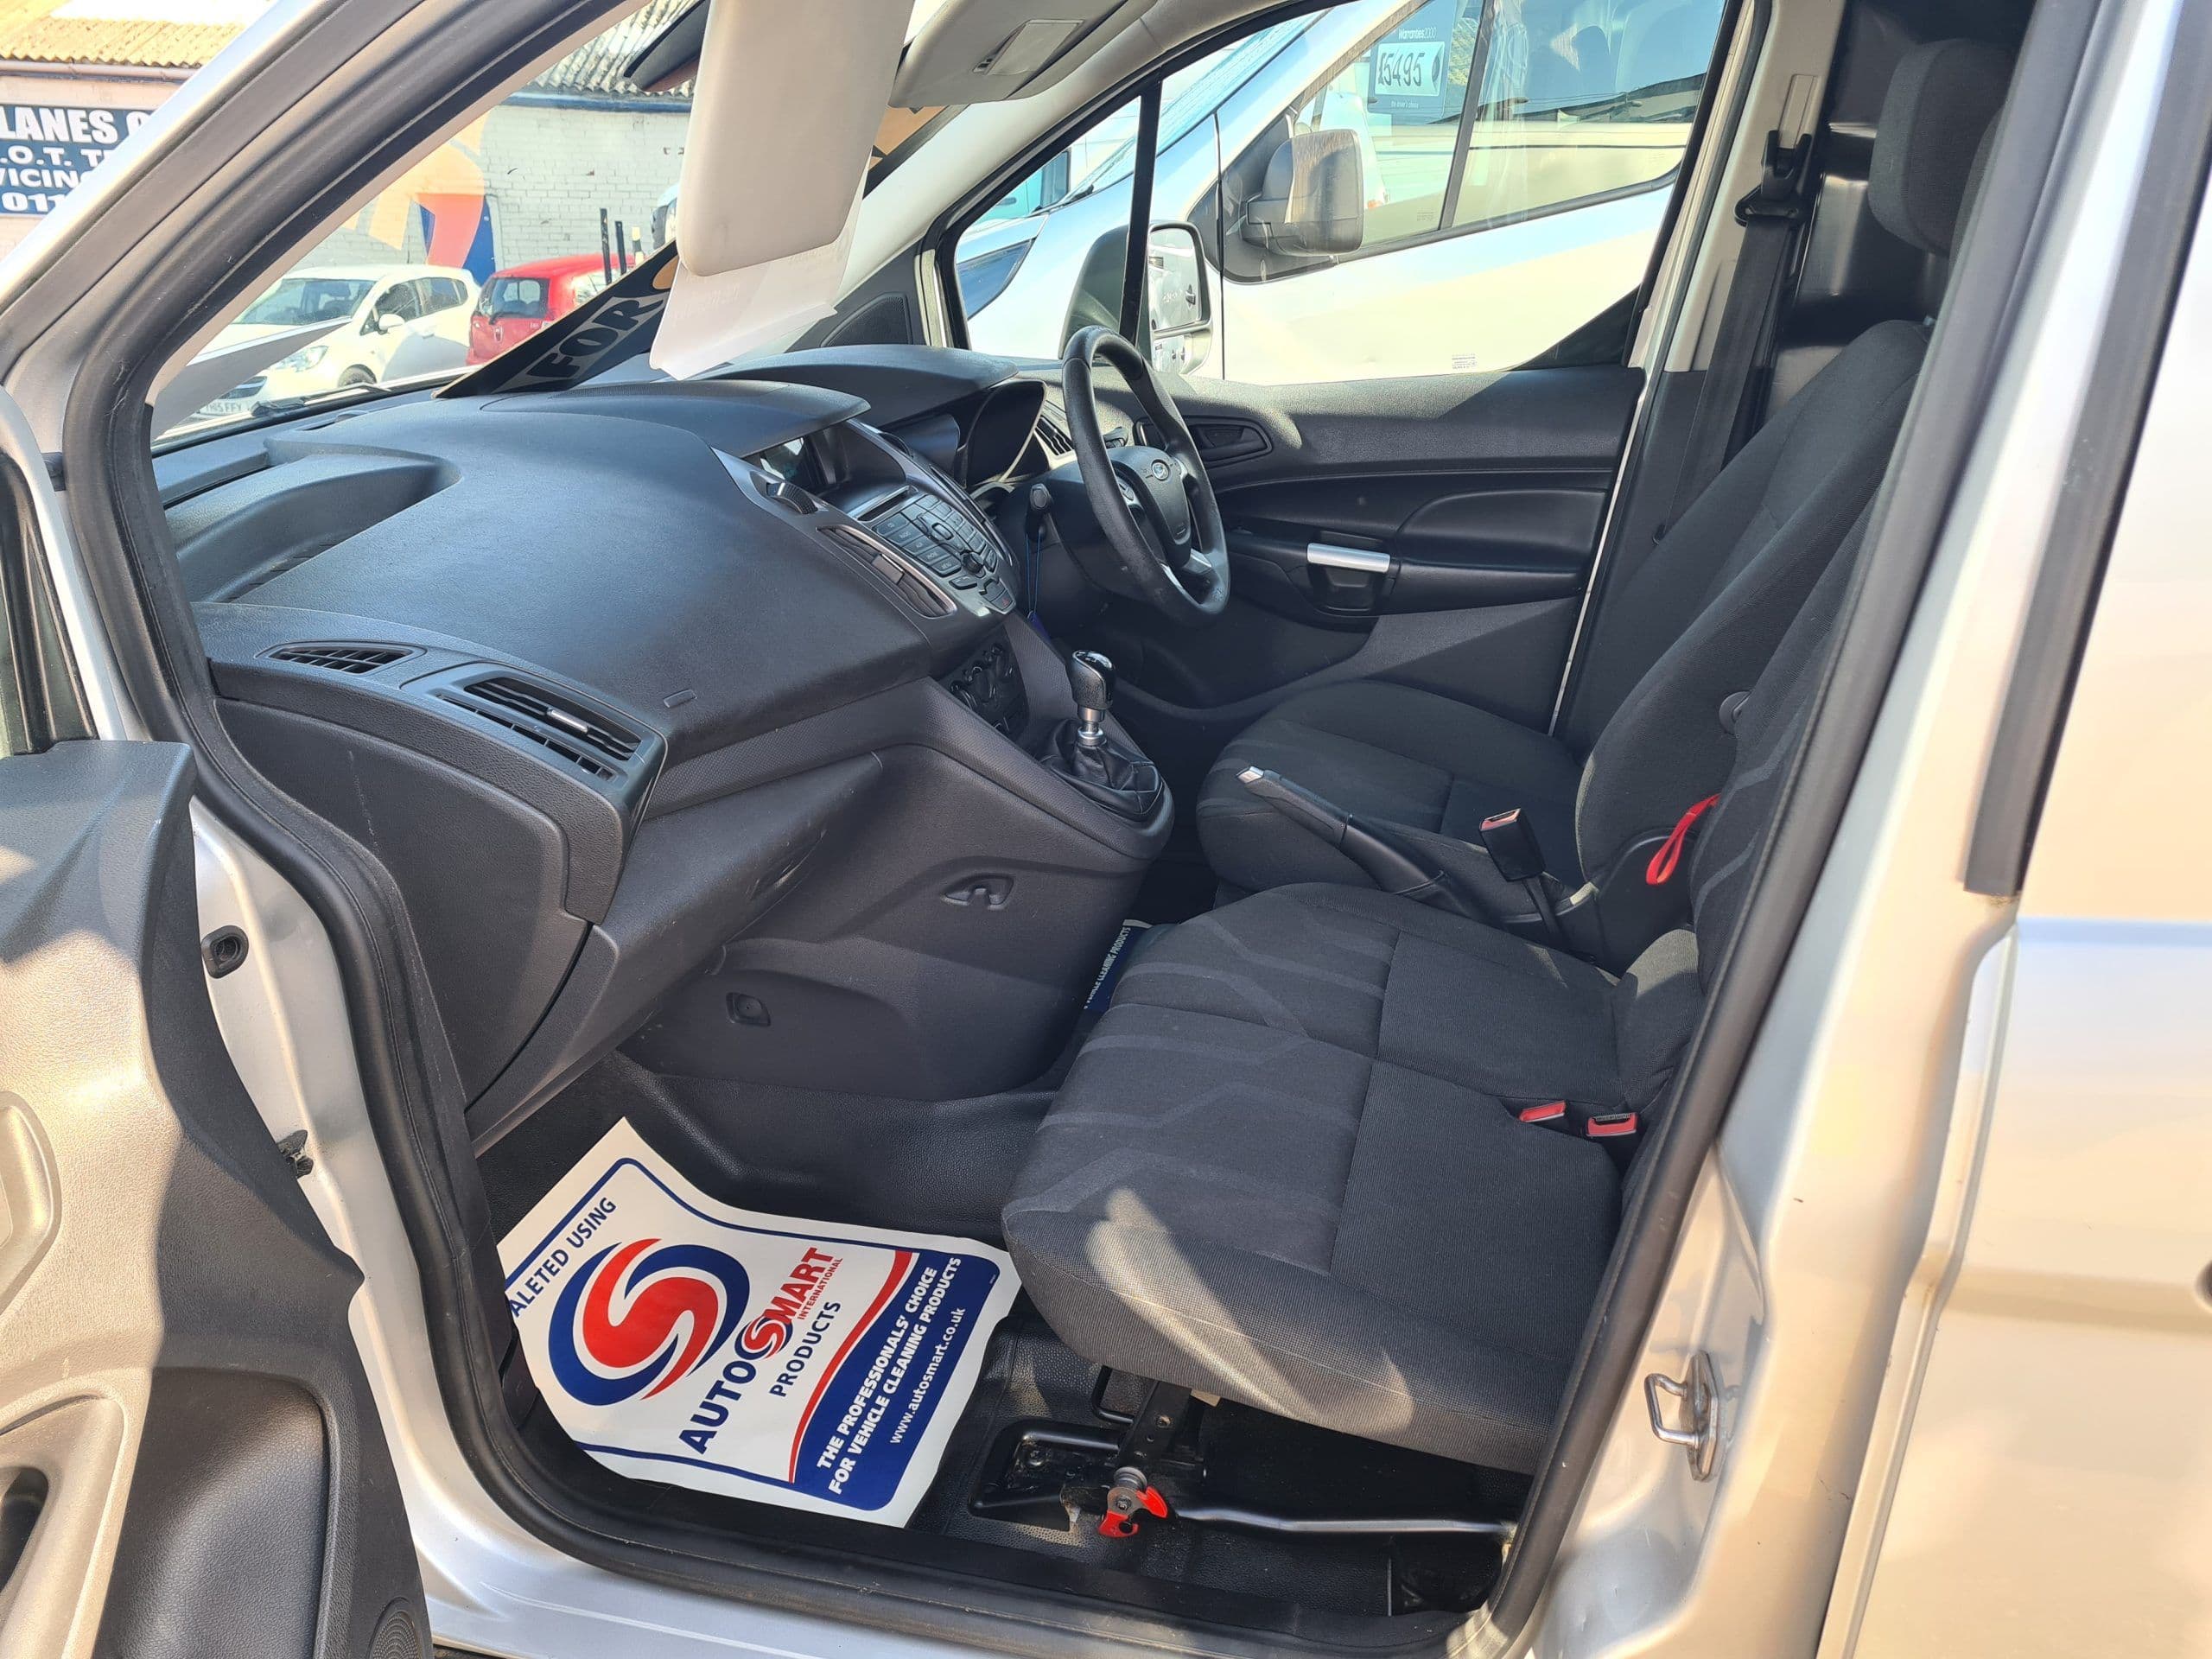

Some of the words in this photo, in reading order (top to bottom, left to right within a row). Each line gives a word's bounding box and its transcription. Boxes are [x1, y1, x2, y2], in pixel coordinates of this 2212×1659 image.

[1378, 52, 1425, 86] £5495
[509, 1249, 569, 1319] ALETED
[566, 1197, 617, 1249] USING
[797, 1257, 843, 1320] INTERNATIONAL
[769, 1301, 842, 1397] PRODUCTS
[817, 1436, 844, 1469] THE
[836, 1315, 909, 1435] PROFESSIONALS'
[905, 1267, 938, 1313] CHOICE
[828, 1457, 856, 1495] FOR
[848, 1395, 891, 1456] VEHICLE
[882, 1324, 927, 1395] CLEANING
[919, 1257, 962, 1324] PRODUCTS
[889, 1307, 966, 1445] www.autosmart.co.uk
